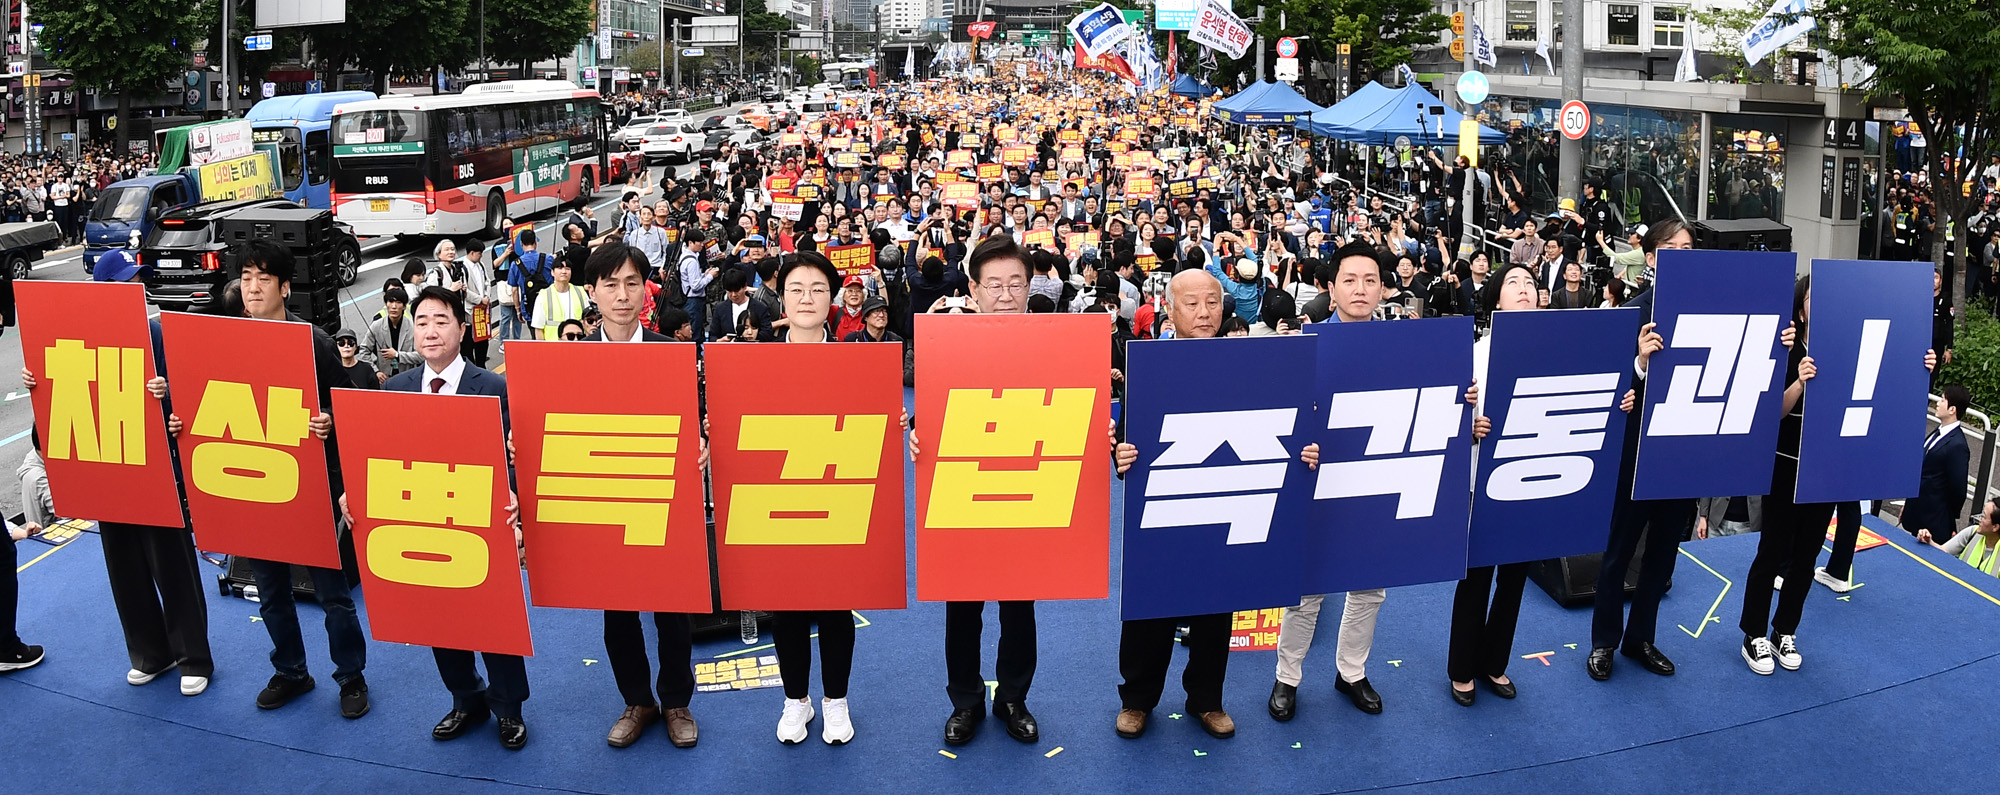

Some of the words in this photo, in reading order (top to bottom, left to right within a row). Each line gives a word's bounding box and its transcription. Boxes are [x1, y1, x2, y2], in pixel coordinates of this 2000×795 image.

[1200, 10, 1228, 38] 윤석열
[1228, 25, 1248, 49] 탄핵
[41, 91, 73, 105] 래방
[1567, 112, 1584, 129] 50
[1827, 120, 1836, 140] 4
[1846, 121, 1857, 141] 4
[213, 164, 240, 185] 너희는
[241, 159, 257, 178] 대체
[830, 246, 871, 260] 대통령의
[850, 256, 870, 267] 거부
[1647, 314, 1776, 436] 과
[1840, 319, 1891, 437] !
[45, 339, 146, 466] 채
[191, 381, 311, 504] 상
[1314, 386, 1464, 519] 각
[1486, 373, 1620, 501] 통
[925, 388, 1097, 529] 법
[536, 413, 681, 546] 특
[725, 415, 888, 545] 검
[1141, 408, 1298, 544] 즉
[366, 458, 493, 588] 병
[1232, 610, 1258, 631] 검
[1249, 632, 1281, 646] 거부
[695, 657, 757, 675] 채상병
[696, 670, 737, 684] 특검
[739, 664, 780, 679] 통과
[697, 683, 731, 692] 국민의
